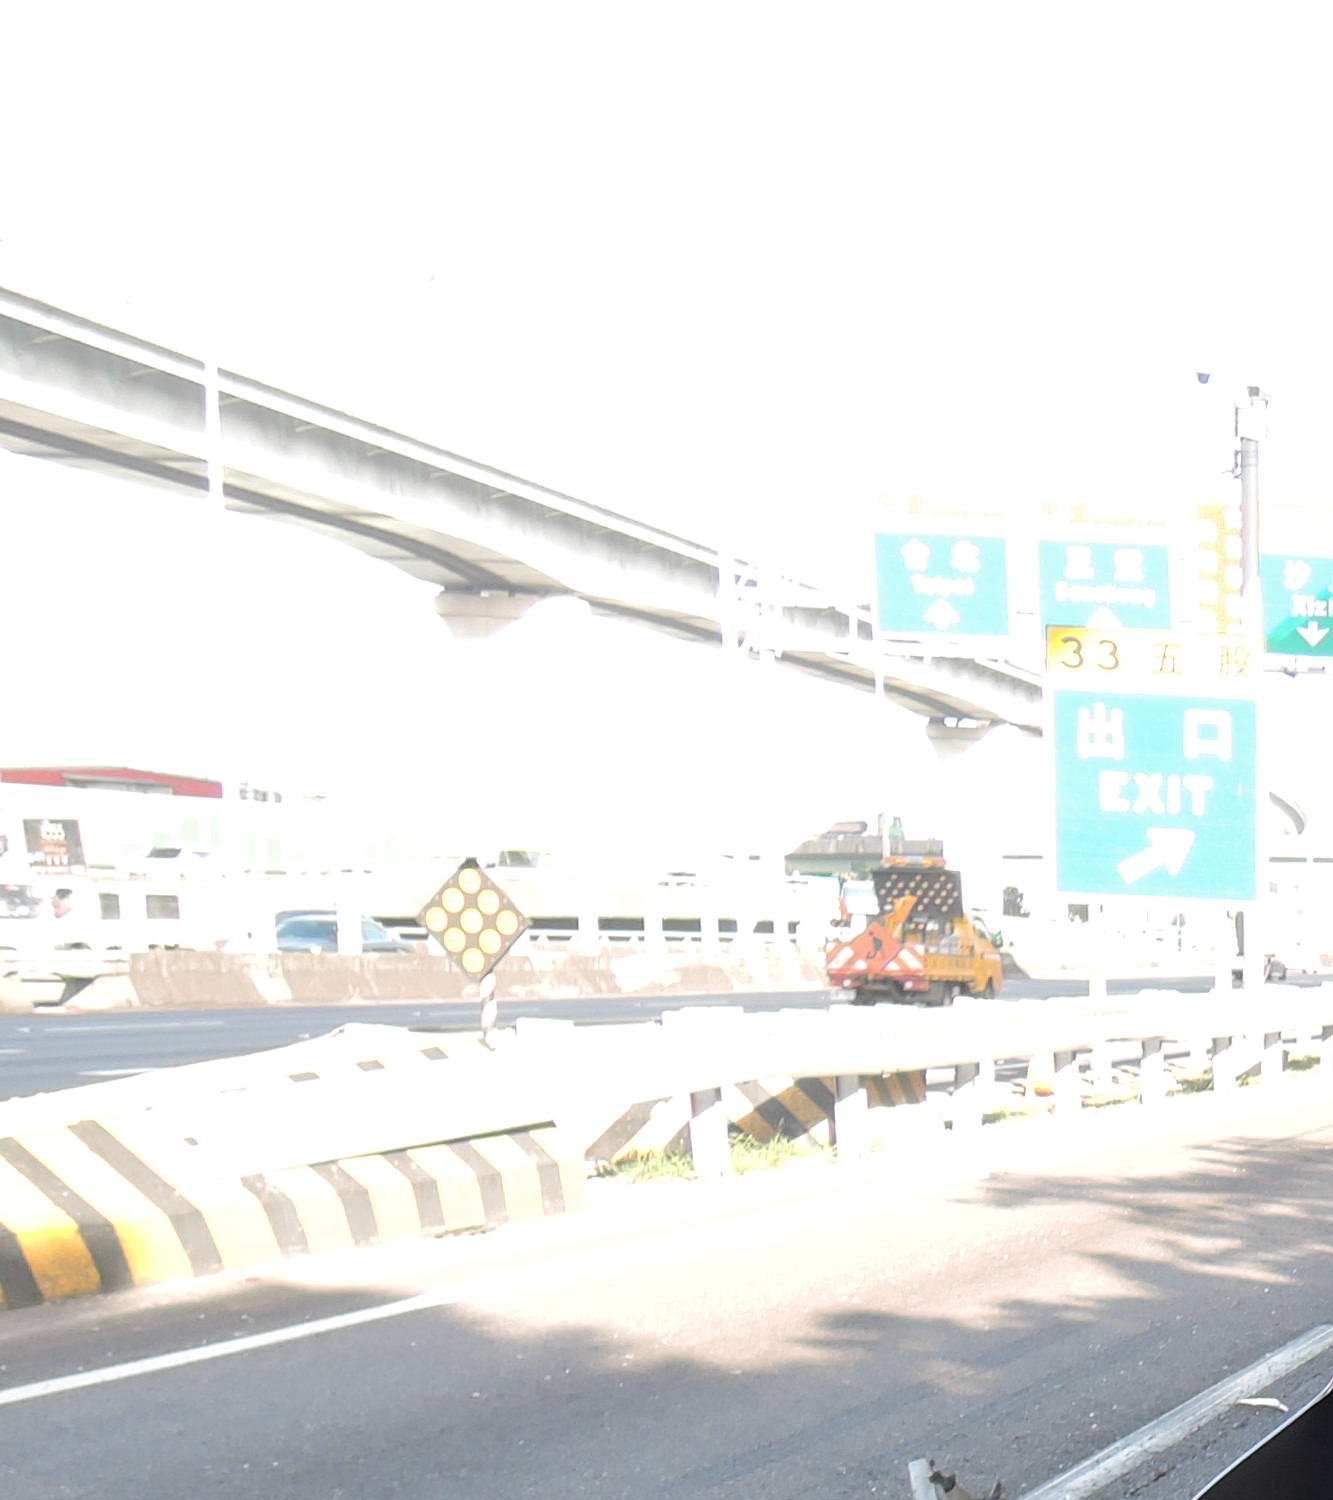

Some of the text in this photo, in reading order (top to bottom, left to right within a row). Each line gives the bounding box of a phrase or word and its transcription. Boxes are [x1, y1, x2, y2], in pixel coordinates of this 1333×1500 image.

[1062, 637, 1119, 670] 33
[1076, 702, 1232, 761] 出口
[1098, 770, 1213, 816] EXIT
